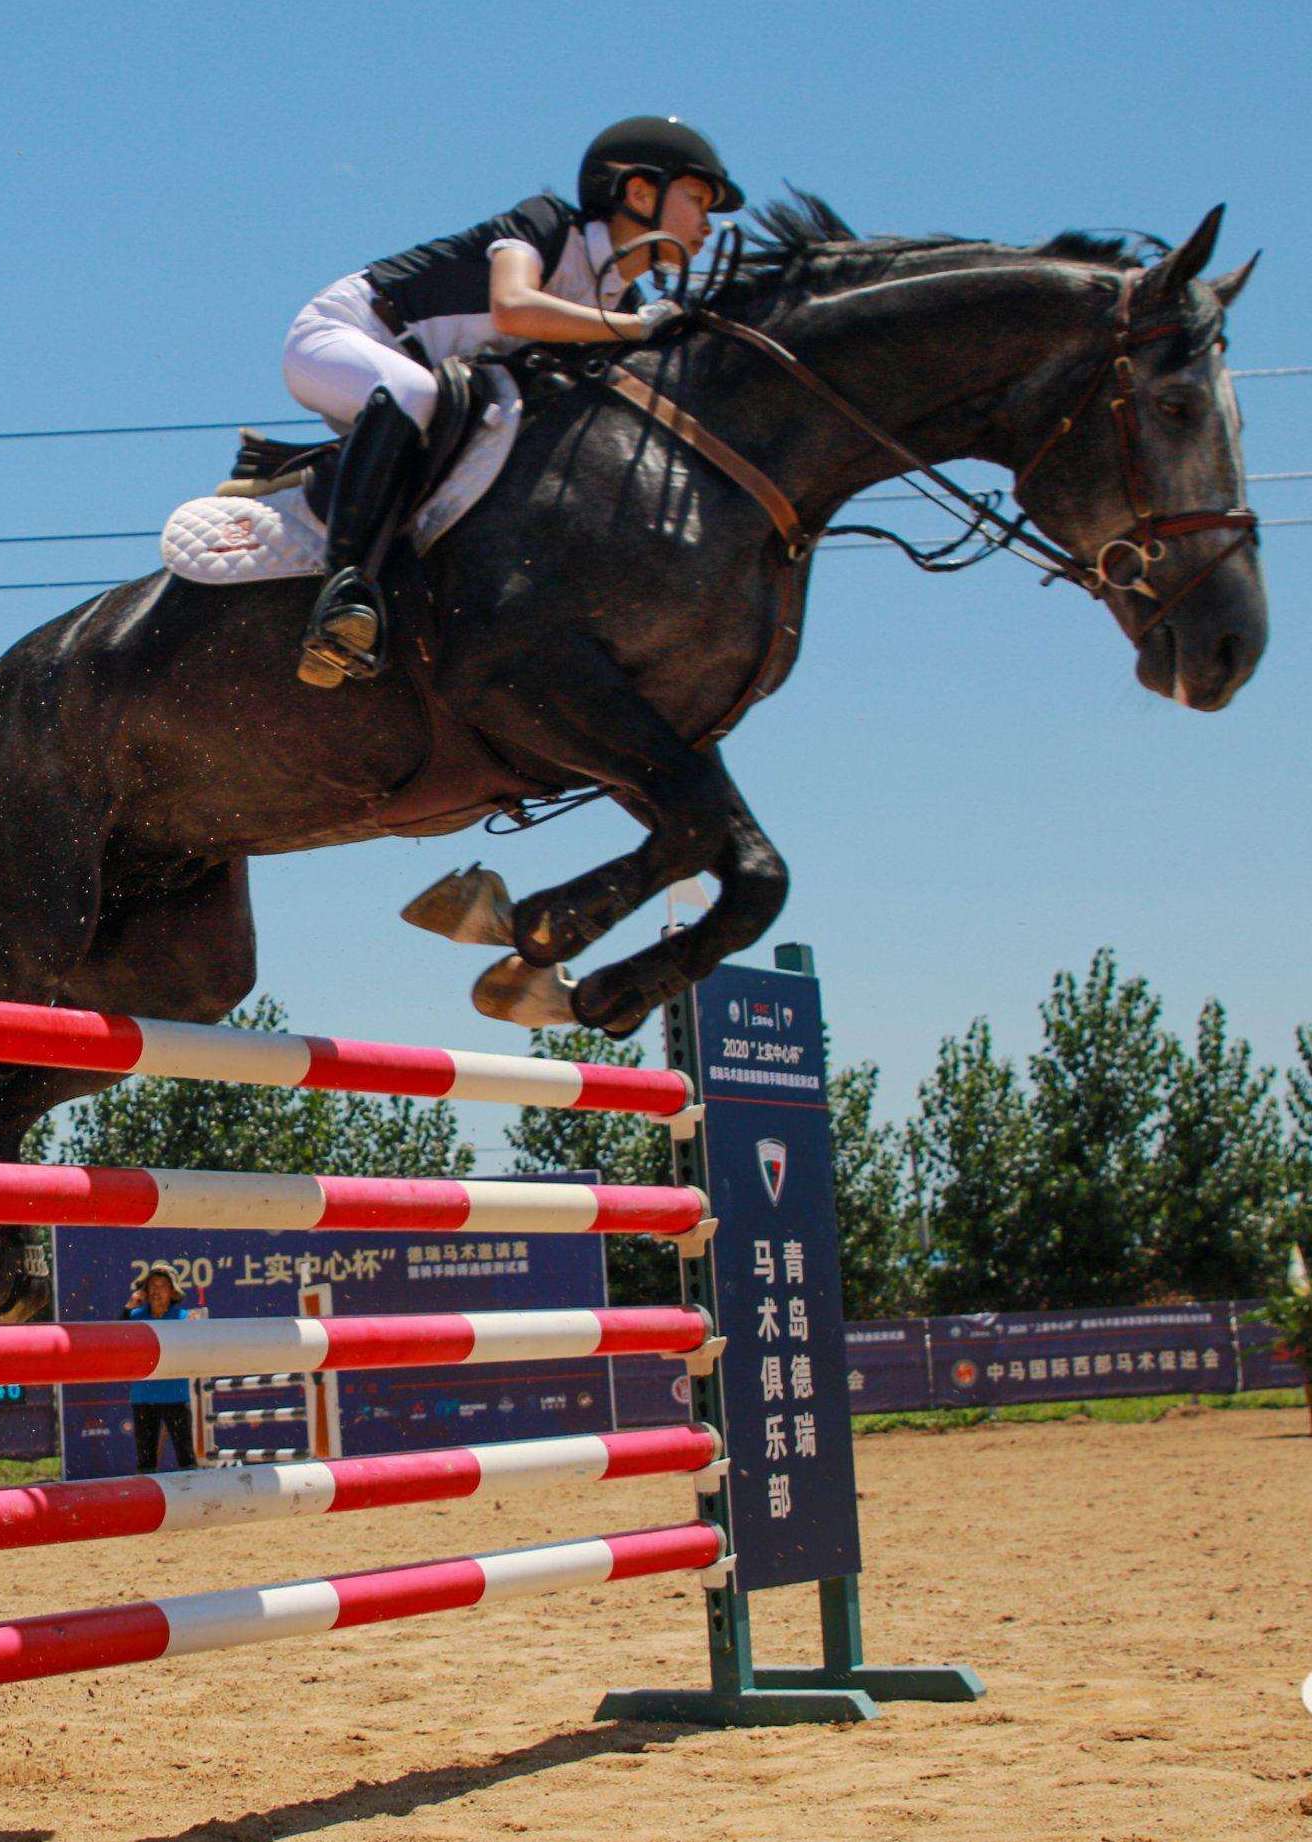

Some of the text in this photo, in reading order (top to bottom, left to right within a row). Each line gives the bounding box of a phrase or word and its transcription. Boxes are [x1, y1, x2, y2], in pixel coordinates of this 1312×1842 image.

[753, 1239, 792, 1519] 马术俱乐部
[782, 1239, 817, 1458] 青岛德瑞
